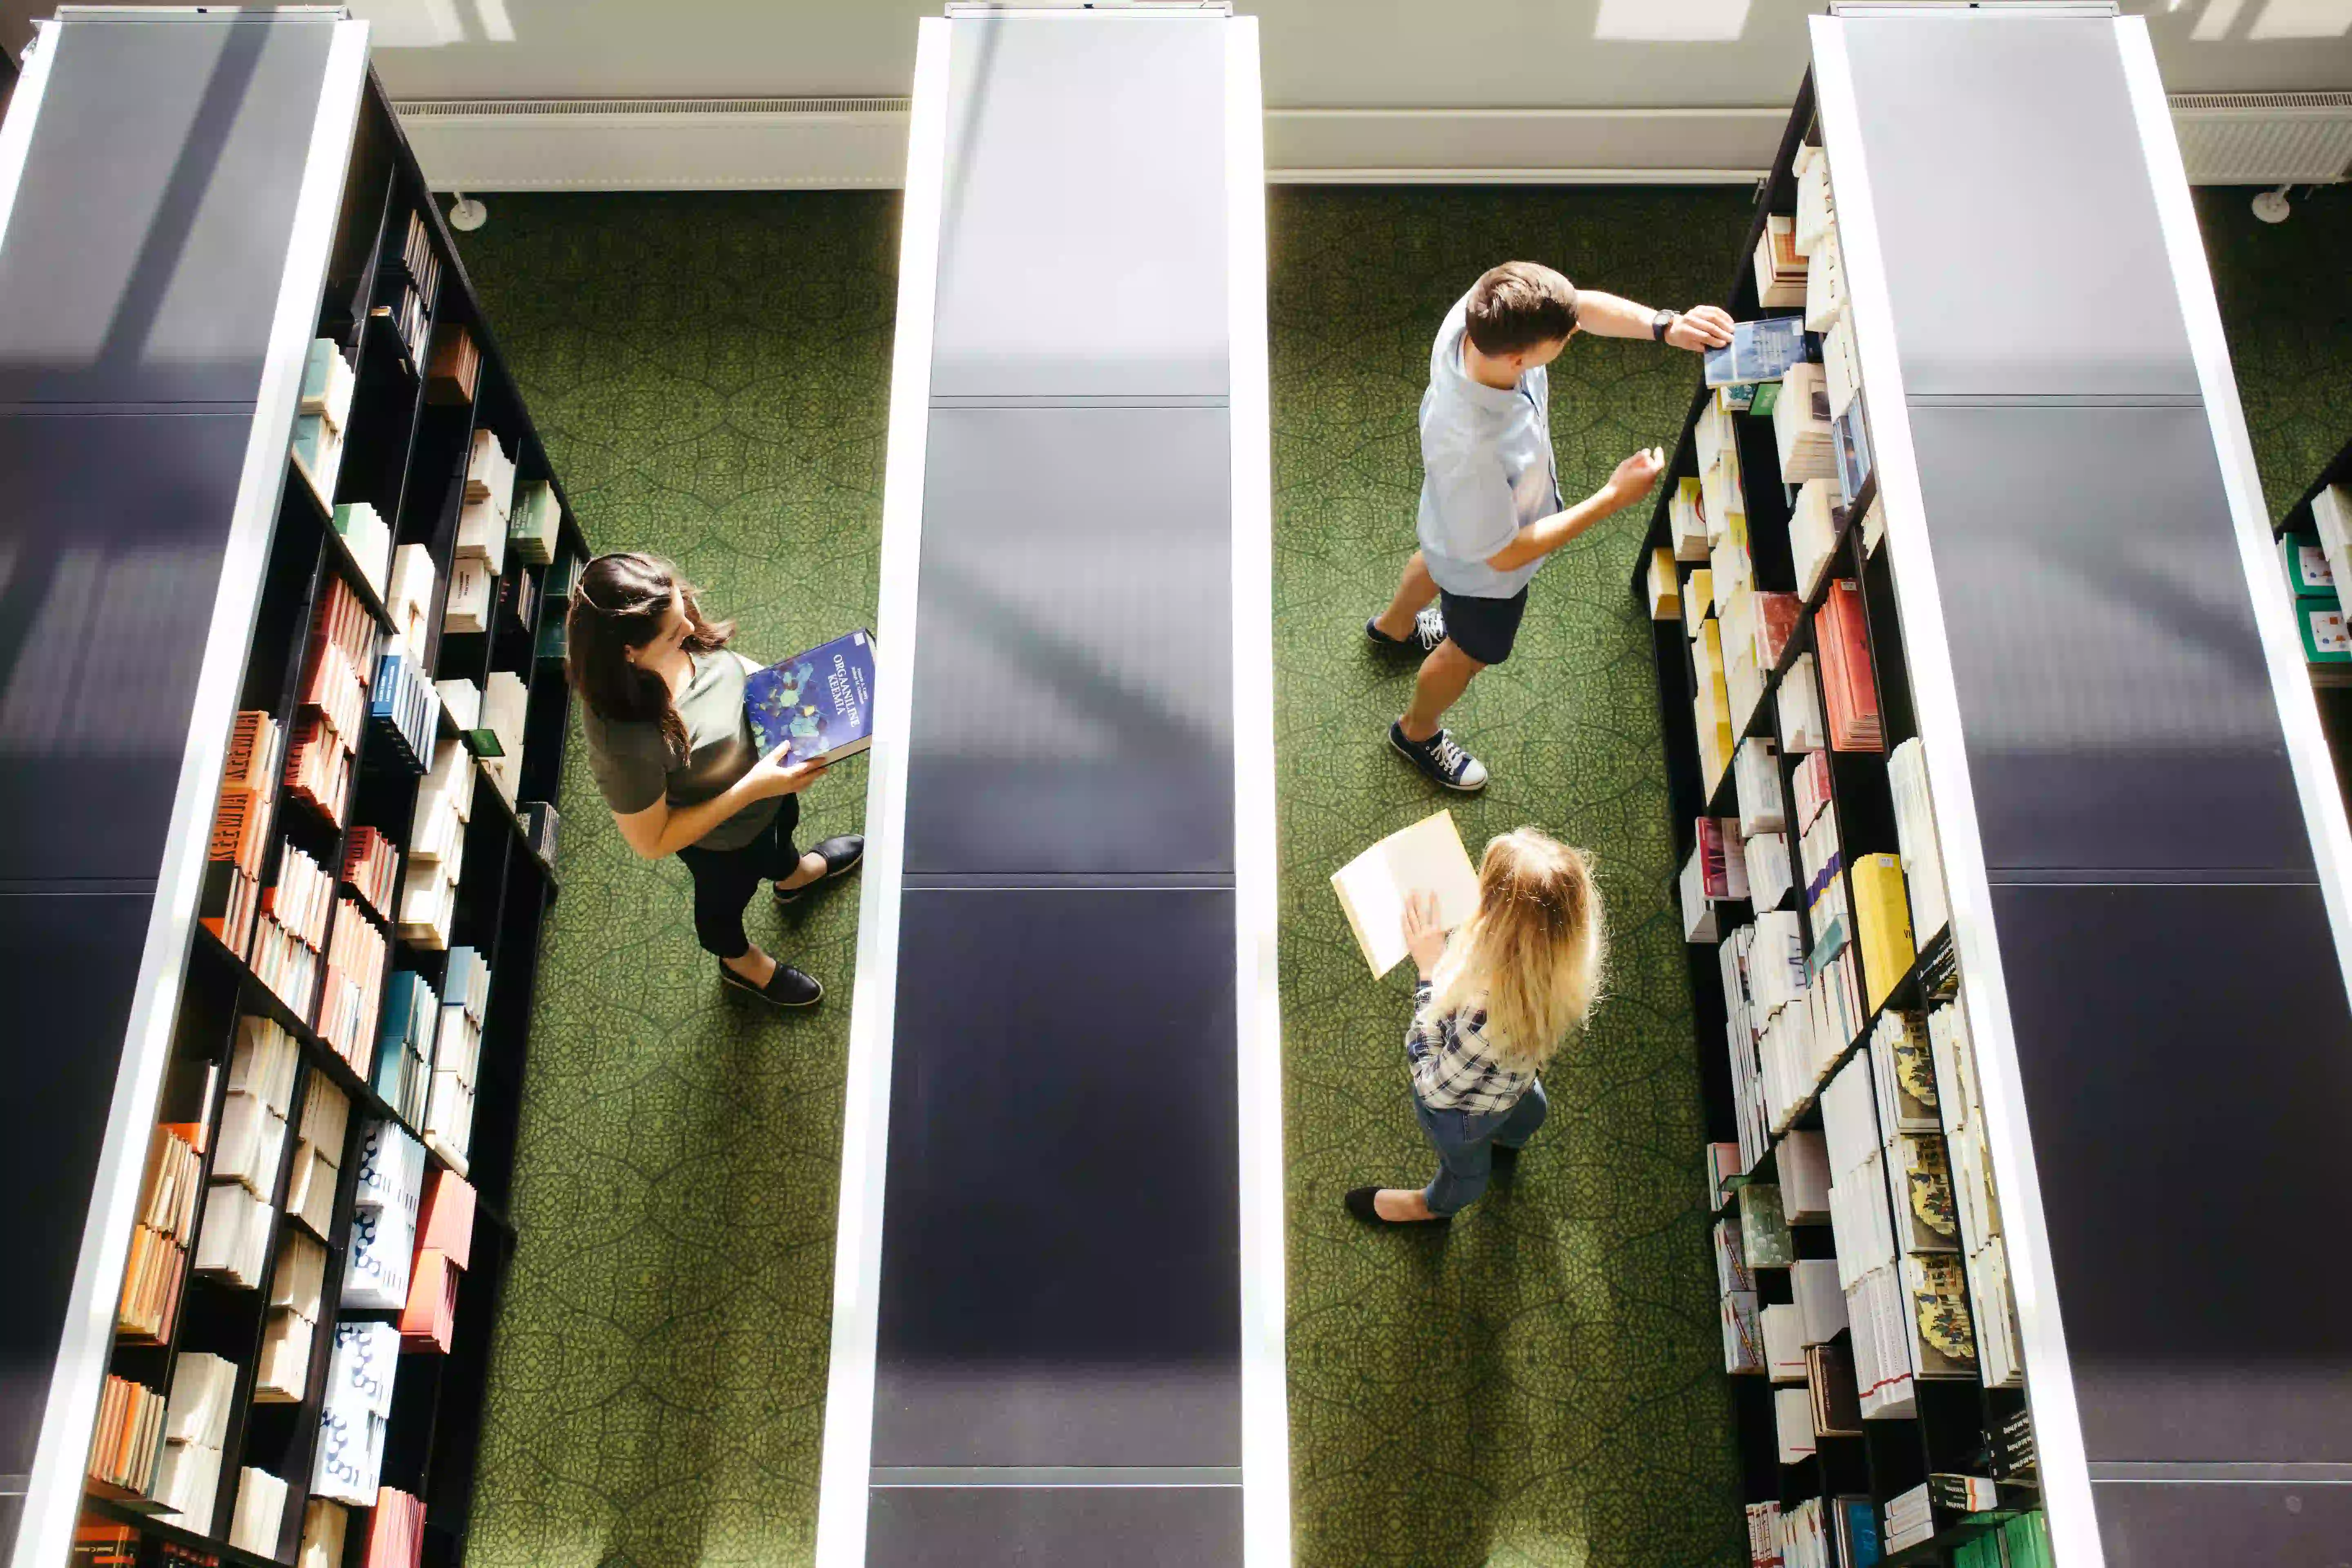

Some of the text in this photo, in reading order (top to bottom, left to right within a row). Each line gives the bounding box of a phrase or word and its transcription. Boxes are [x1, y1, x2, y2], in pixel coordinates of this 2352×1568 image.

[828, 673, 846, 715] KEEMIA
[833, 654, 860, 727] ORGAANILINE
[210, 793, 249, 860] KEEMIA
